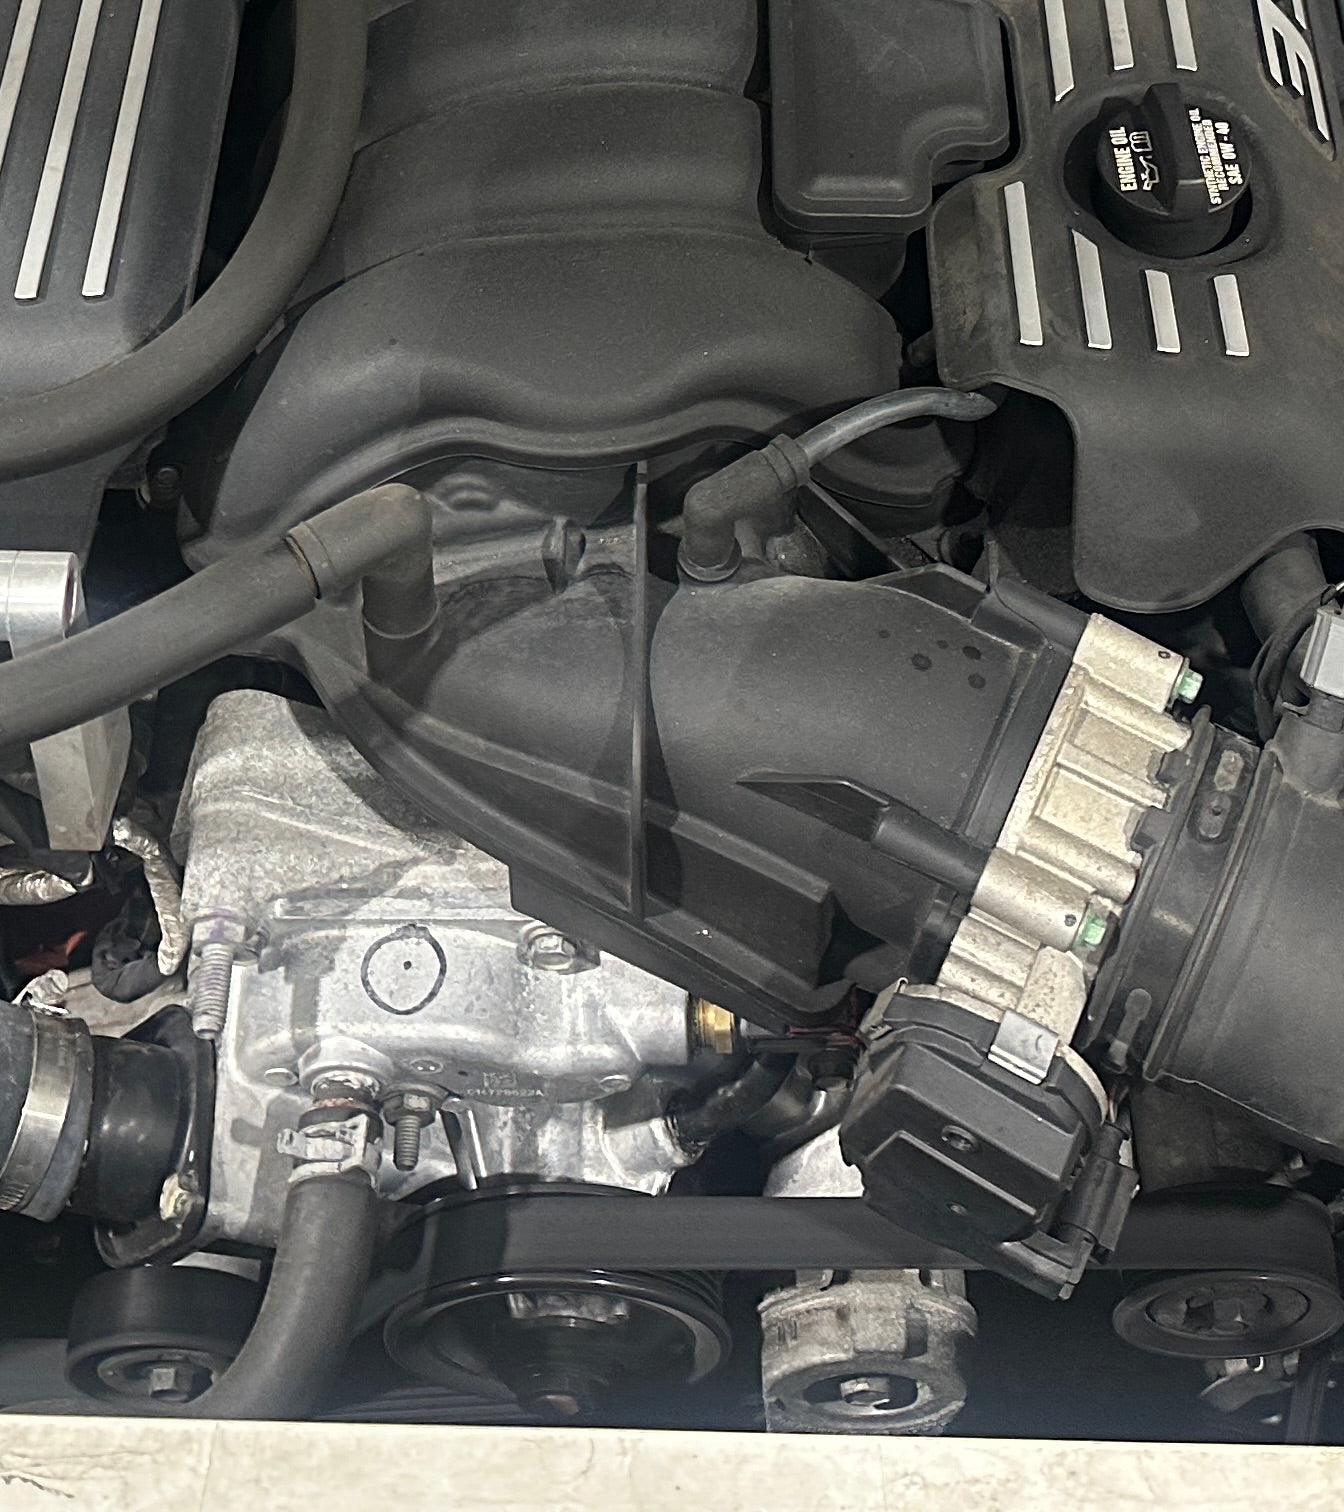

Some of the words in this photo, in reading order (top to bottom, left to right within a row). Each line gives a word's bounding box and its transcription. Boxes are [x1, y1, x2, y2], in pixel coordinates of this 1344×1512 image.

[1108, 126, 1130, 145] OIL
[1191, 122, 1209, 154] ENGINE
[1201, 118, 1230, 191] RECOMMENDED
[1113, 146, 1138, 191] ENGINE
[1199, 155, 1222, 205] SYNTHETIC
[1224, 163, 1243, 185] SAE
